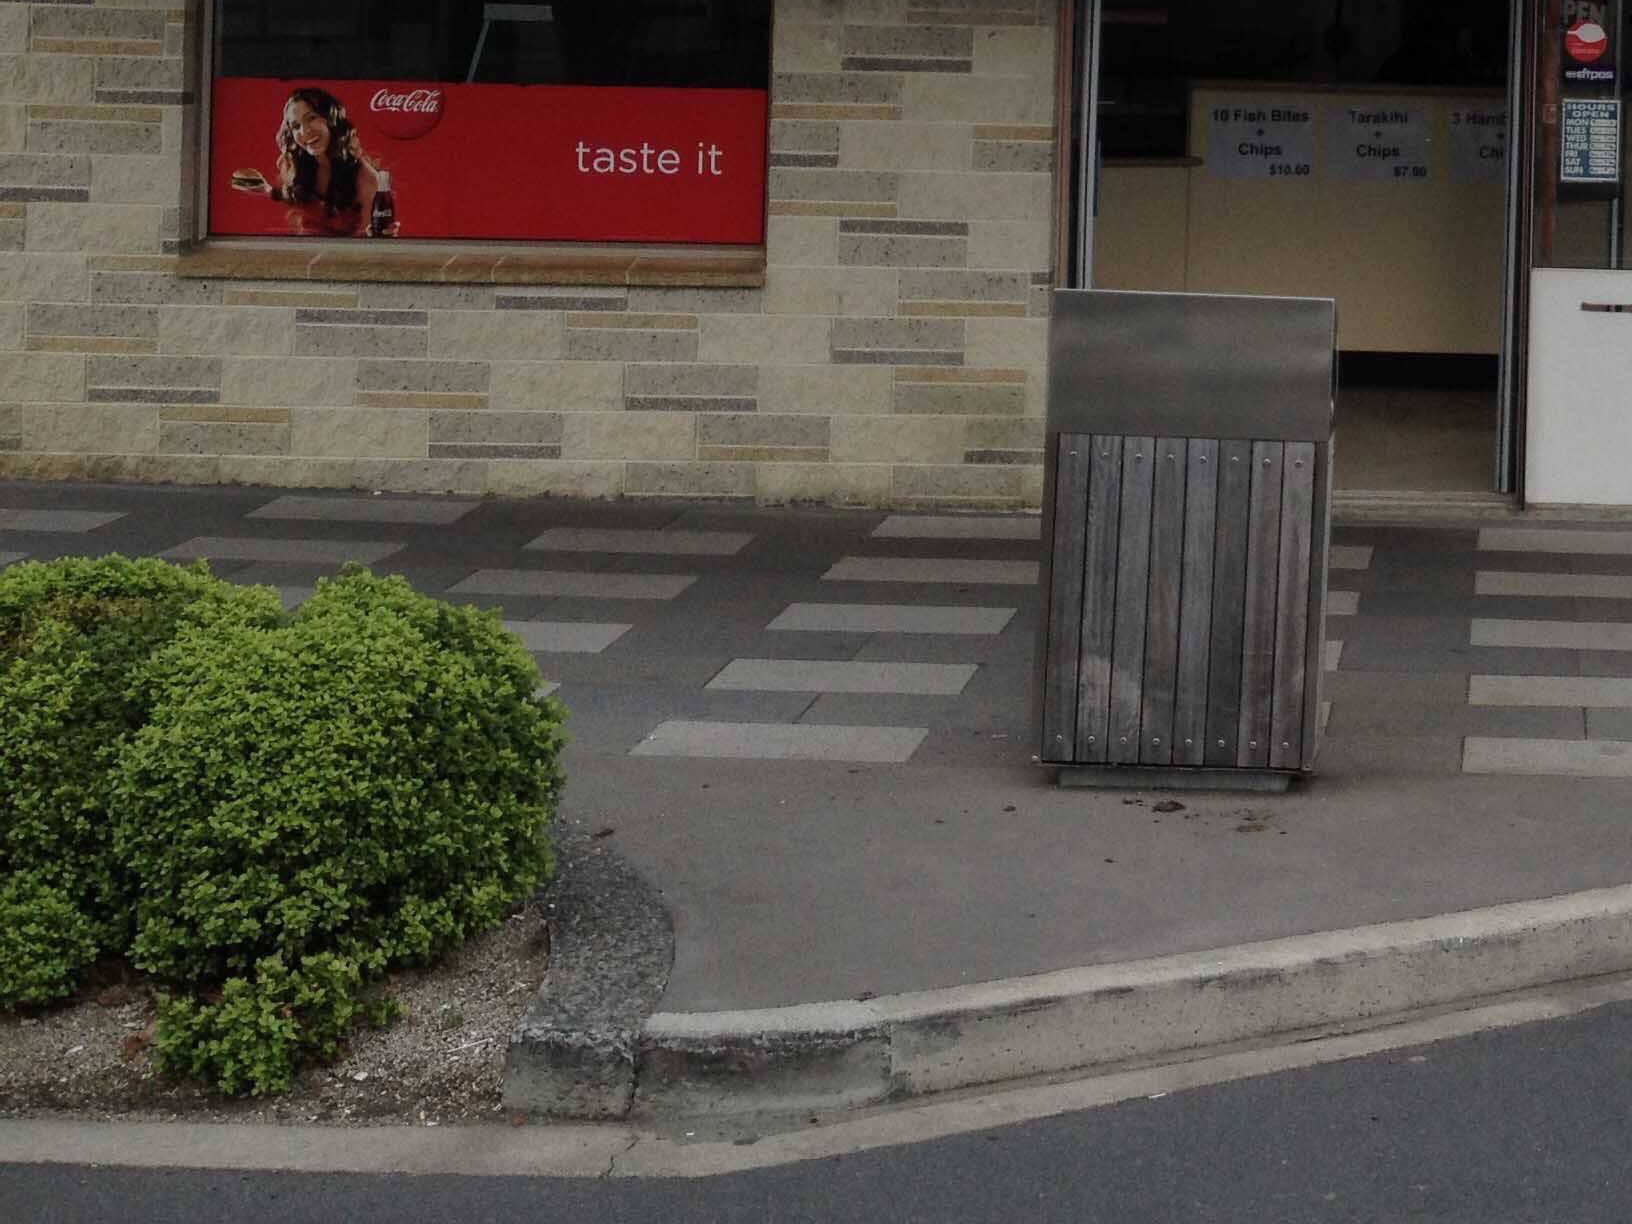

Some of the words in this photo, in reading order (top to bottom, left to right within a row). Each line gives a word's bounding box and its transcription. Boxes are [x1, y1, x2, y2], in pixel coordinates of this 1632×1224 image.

[370, 88, 441, 114] Coca-Cola
[1566, 103, 1616, 111] HOURS
[1234, 108, 1267, 123] Fish
[1271, 109, 1310, 123] Bites
[1347, 109, 1409, 125] Tarakihi
[1572, 110, 1610, 119] OPEN
[1565, 118, 1590, 127] MON
[1566, 134, 1587, 143] WED
[576, 141, 681, 175] taste
[696, 142, 723, 175] it
[1238, 142, 1284, 160] Chips
[1356, 144, 1401, 161] Chips
[1564, 158, 1581, 166] SAT
